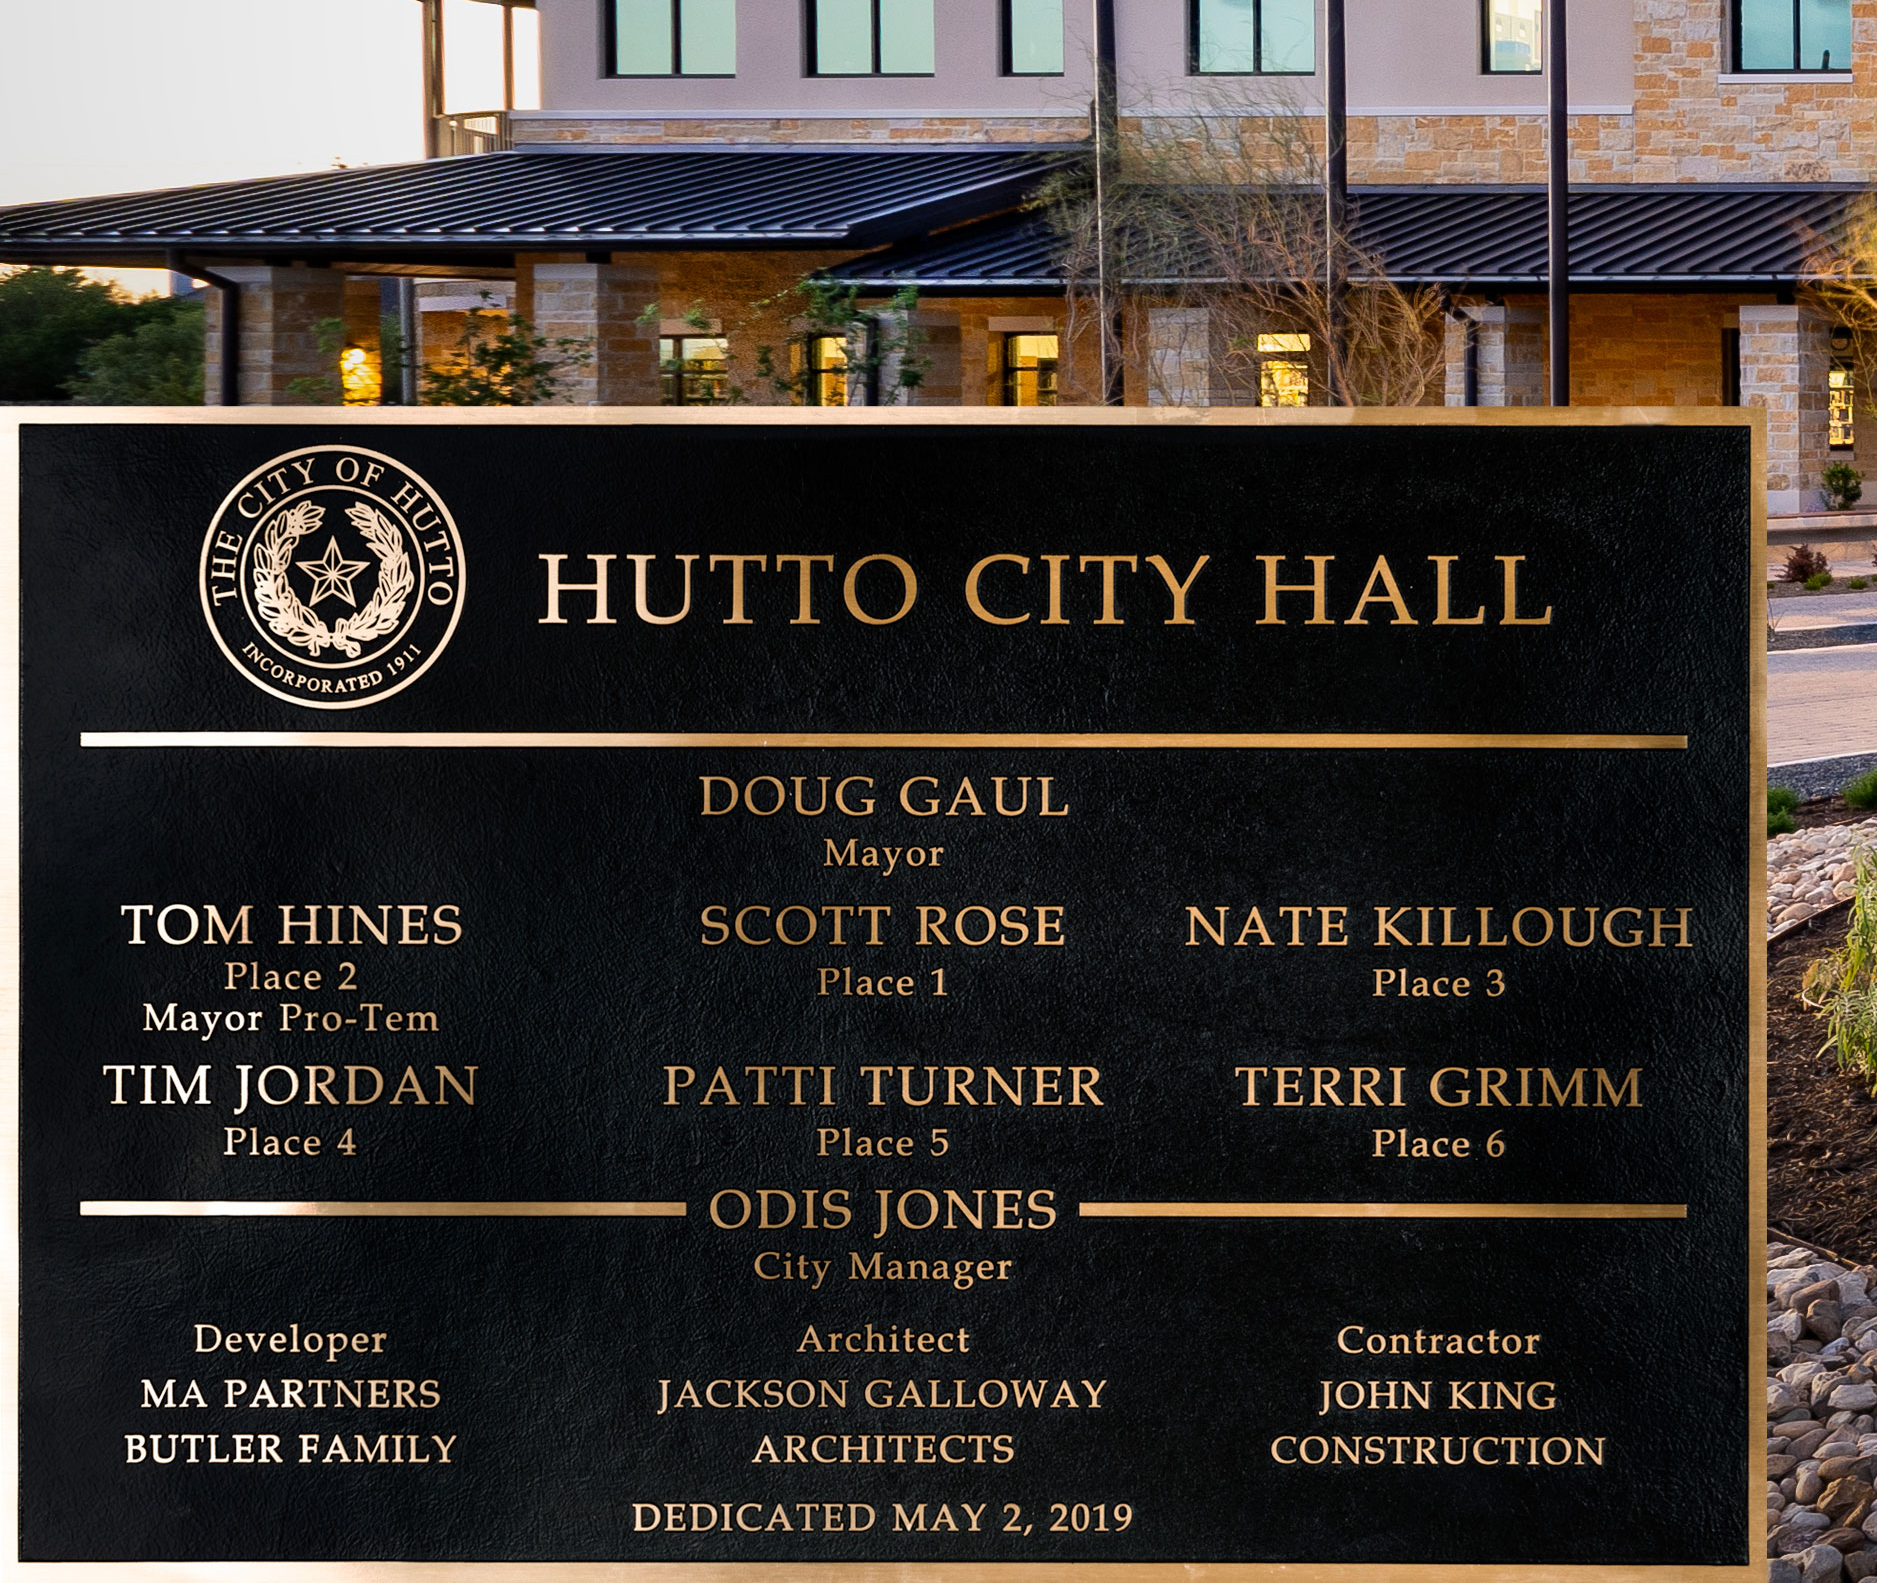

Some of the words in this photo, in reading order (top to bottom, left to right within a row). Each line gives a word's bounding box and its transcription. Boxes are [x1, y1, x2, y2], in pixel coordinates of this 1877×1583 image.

[210, 529, 244, 607] THE
[237, 457, 316, 519] CITY
[335, 456, 385, 488] OF
[390, 480, 455, 607] HUTTO
[539, 554, 917, 624] HUTTO
[966, 554, 1210, 625] CITY
[1256, 555, 1553, 625] HALL
[242, 641, 384, 694] INCORPORATED
[386, 643, 422, 676] 1911
[699, 776, 875, 816] DOUG
[900, 776, 1069, 817] GAUL
[824, 839, 943, 876] Mayor
[121, 904, 253, 945] TOM
[278, 904, 462, 945] HINES
[702, 906, 891, 945] SCOTT
[916, 906, 1065, 946] ROSE
[1186, 906, 1348, 946] NATE
[1374, 907, 1693, 947] KILLOUGH
[225, 961, 321, 990] Place
[339, 961, 357, 990] 2
[818, 967, 913, 996] Place
[931, 967, 947, 995] 1
[1373, 968, 1470, 997] Place
[1487, 968, 1506, 997] 3
[143, 1003, 262, 1041] Mayor
[280, 1003, 439, 1032] Pro-Tem
[103, 1064, 211, 1105] TIM
[234, 1065, 478, 1115] JORDAN
[664, 1066, 836, 1106] PATTI
[860, 1066, 1104, 1106] TURNER
[1235, 1067, 1406, 1107] TERRI
[1430, 1067, 1644, 1107] GRIMM
[224, 1127, 321, 1156] Place
[337, 1128, 357, 1156] 4
[817, 1127, 914, 1157] Place
[930, 1128, 949, 1157] 5
[1373, 1128, 1470, 1158] Place
[1487, 1129, 1505, 1158] 6
[710, 1189, 851, 1230] ODIS
[874, 1190, 1056, 1239] JONES
[754, 1251, 831, 1289] City
[849, 1251, 1012, 1290] Manager
[194, 1324, 387, 1363] Developer
[797, 1324, 970, 1353] Architect
[1338, 1325, 1540, 1355] Contractor
[141, 1379, 208, 1408] MA
[224, 1378, 441, 1409] PARTNERS
[657, 1379, 848, 1415] JACKSON
[864, 1379, 1107, 1409] GALLOWAY
[1319, 1381, 1432, 1416] JOHN
[1449, 1381, 1556, 1410] KING
[125, 1434, 283, 1464] BUTLER
[299, 1434, 457, 1464] FAMILY
[752, 1434, 1014, 1464] ARCHITECTS
[1271, 1436, 1605, 1466] CONSTRUCTION
[632, 1503, 876, 1532] DEDICATED
[892, 1503, 987, 1532] MAY
[1003, 1503, 1033, 1537] 2,
[1050, 1503, 1133, 1533] 2019
